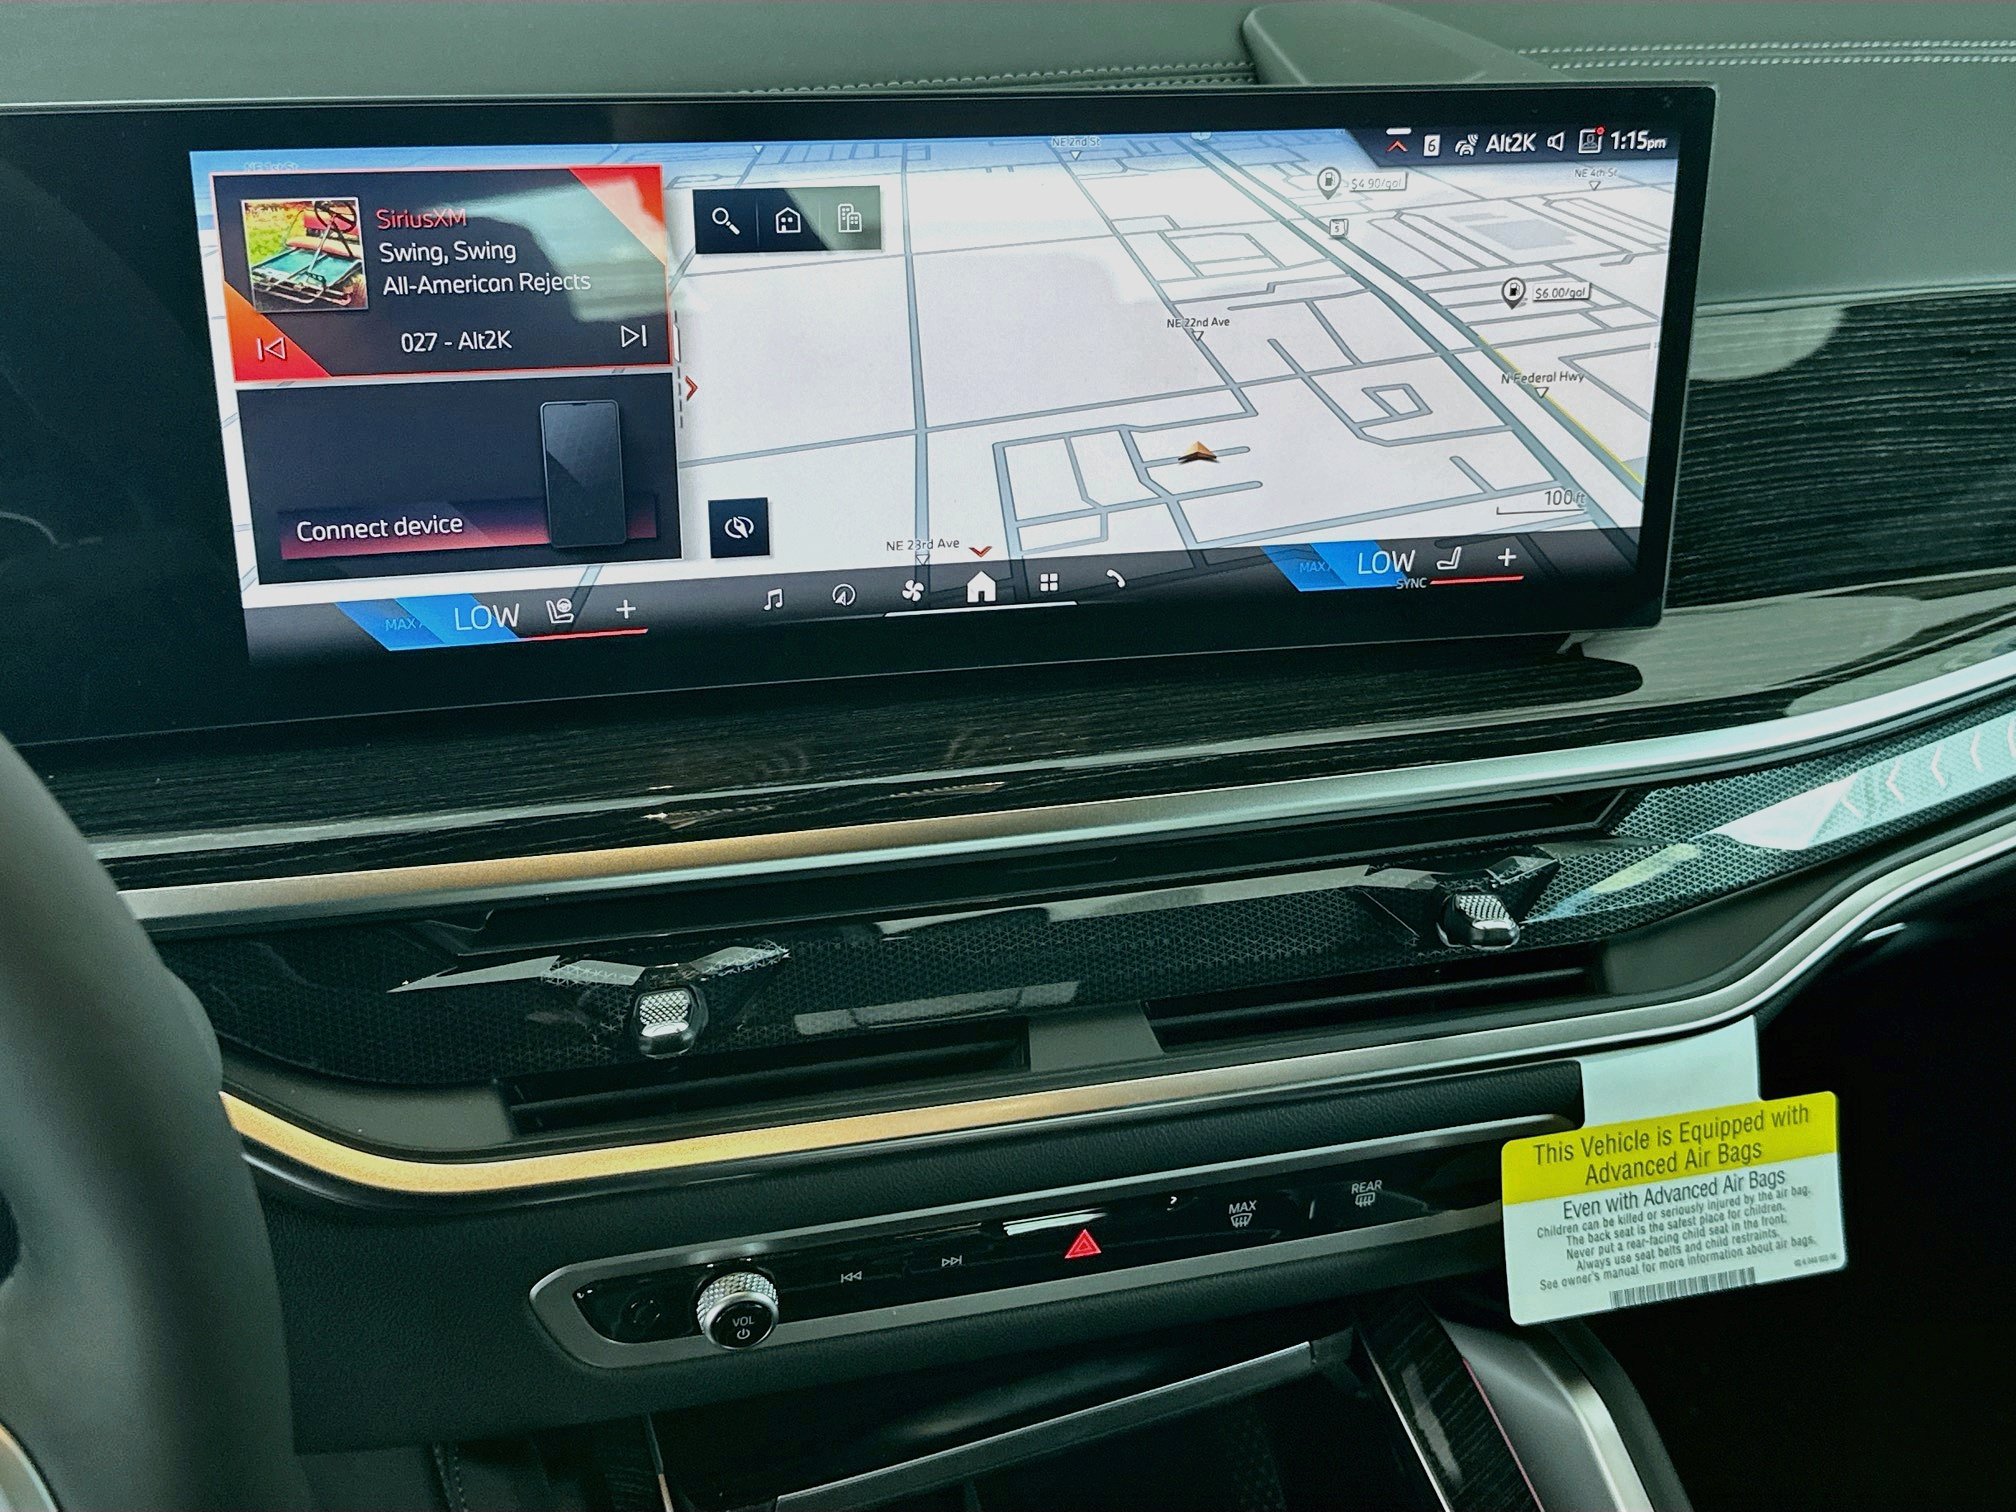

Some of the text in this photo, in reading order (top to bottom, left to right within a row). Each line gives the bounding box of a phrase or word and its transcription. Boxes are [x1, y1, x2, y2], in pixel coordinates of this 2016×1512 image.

[1052, 137, 1100, 147] NE 2nd St
[1485, 133, 1537, 152] Alt2K
[1610, 130, 1668, 151] 1:15pm
[1574, 168, 1587, 178] NE
[1351, 178, 1402, 191] $490/gal
[376, 207, 467, 230] SiriusXM
[380, 241, 517, 264] Swing, Swing
[382, 273, 592, 296] All-American Rejects
[1535, 287, 1585, 299] $6.00/gal
[1166, 317, 1230, 328] NE 22nd Ave
[400, 333, 438, 353] 027
[458, 330, 512, 351] Alt2K
[1501, 371, 1585, 384] N Federal Hwy
[1545, 490, 1572, 505] 100
[296, 514, 464, 543] Connect device
[886, 538, 960, 551] NE 23rd Ave
[1300, 561, 1324, 573] MAX
[1357, 549, 1416, 575] LOW
[1396, 578, 1428, 589] SYNC
[385, 617, 417, 632] MAX
[454, 603, 520, 632] LOW
[1533, 1103, 1809, 1166] This Vehicle is Equipped with
[1585, 1141, 1763, 1186] Advanced Air Bags
[1351, 1179, 1383, 1194] REAR
[1563, 1169, 1786, 1220] Even with Advanced Air Bags
[1228, 1200, 1257, 1215] MAX
[1536, 1185, 1812, 1239] Children can be killed or seriously injured by the air bag.
[1566, 1200, 1786, 1246] The back seat is the safest place for children.
[1566, 1246, 1595, 1260] Never
[1598, 1242, 1615, 1257] put
[1626, 1231, 1680, 1251] rear-facing
[1682, 1226, 1706, 1241] child
[1708, 1222, 1729, 1236] seat
[1731, 1221, 1741, 1232] in
[1743, 1217, 1759, 1230] the
[1761, 1212, 1788, 1226] front.
[1576, 1227, 1780, 1272] Always use seat belts and child restraints.
[1539, 1234, 1816, 1292] See owner's manual for more information about air bags.
[732, 1316, 755, 1328] VOL
